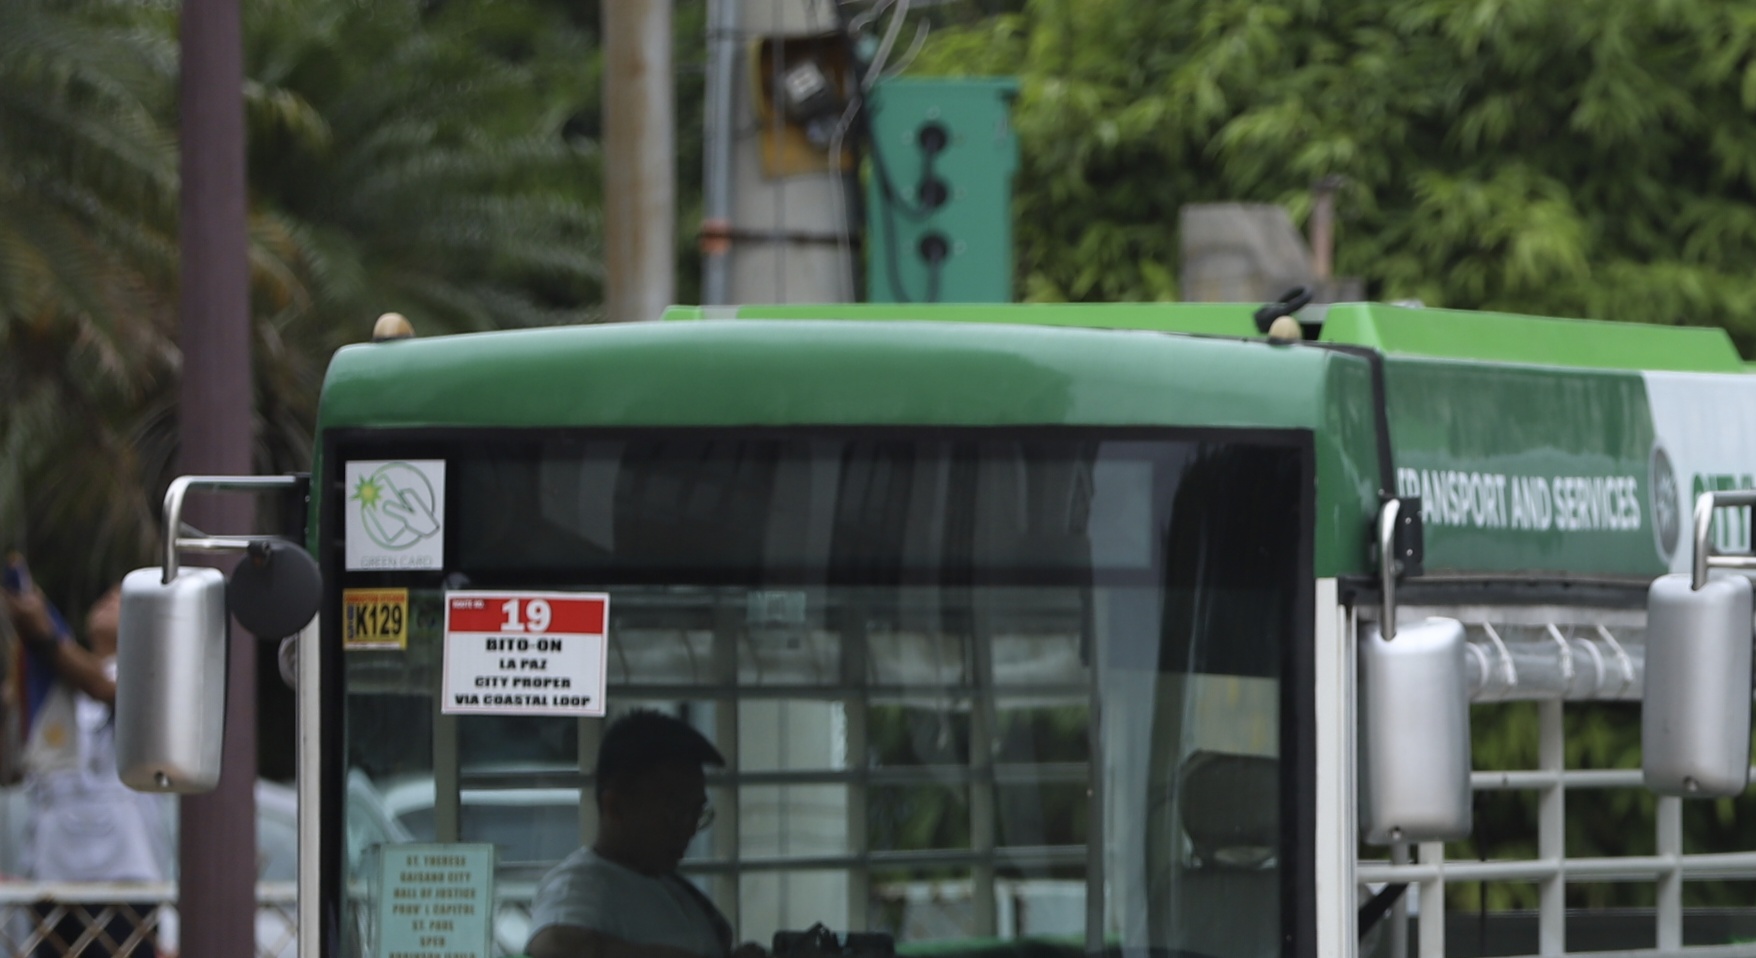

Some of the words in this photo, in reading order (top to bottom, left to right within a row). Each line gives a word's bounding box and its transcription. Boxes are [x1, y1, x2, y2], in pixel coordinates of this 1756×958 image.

[1511, 475, 1552, 529] AND
[1554, 475, 1641, 530] SERVICES
[357, 605, 402, 636] K129
[500, 598, 553, 633] 19
[485, 637, 562, 652] BITO-ON
[499, 658, 516, 670] LA
[521, 658, 547, 670] PAZ
[474, 676, 508, 688] CITY
[512, 676, 571, 689] PROPER
[454, 694, 480, 706] VIA
[483, 695, 550, 707] COASTAL
[552, 696, 591, 708] LOOP
